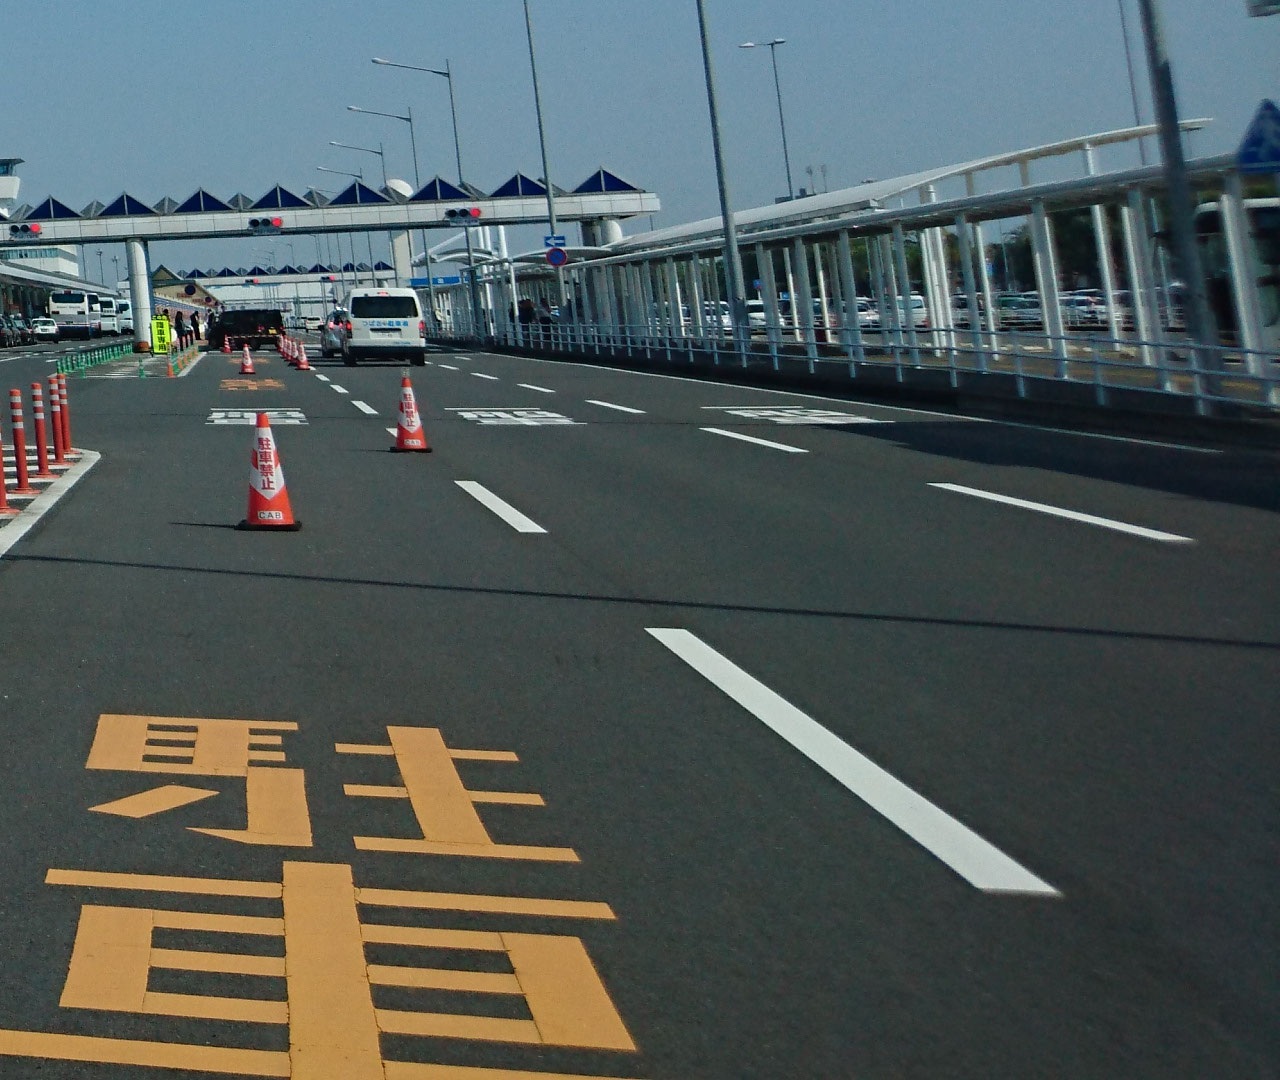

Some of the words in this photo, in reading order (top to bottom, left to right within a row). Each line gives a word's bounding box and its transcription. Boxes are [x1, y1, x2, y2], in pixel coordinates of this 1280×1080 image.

[257, 437, 276, 491] 駐車禁止
[259, 511, 282, 519] CAB
